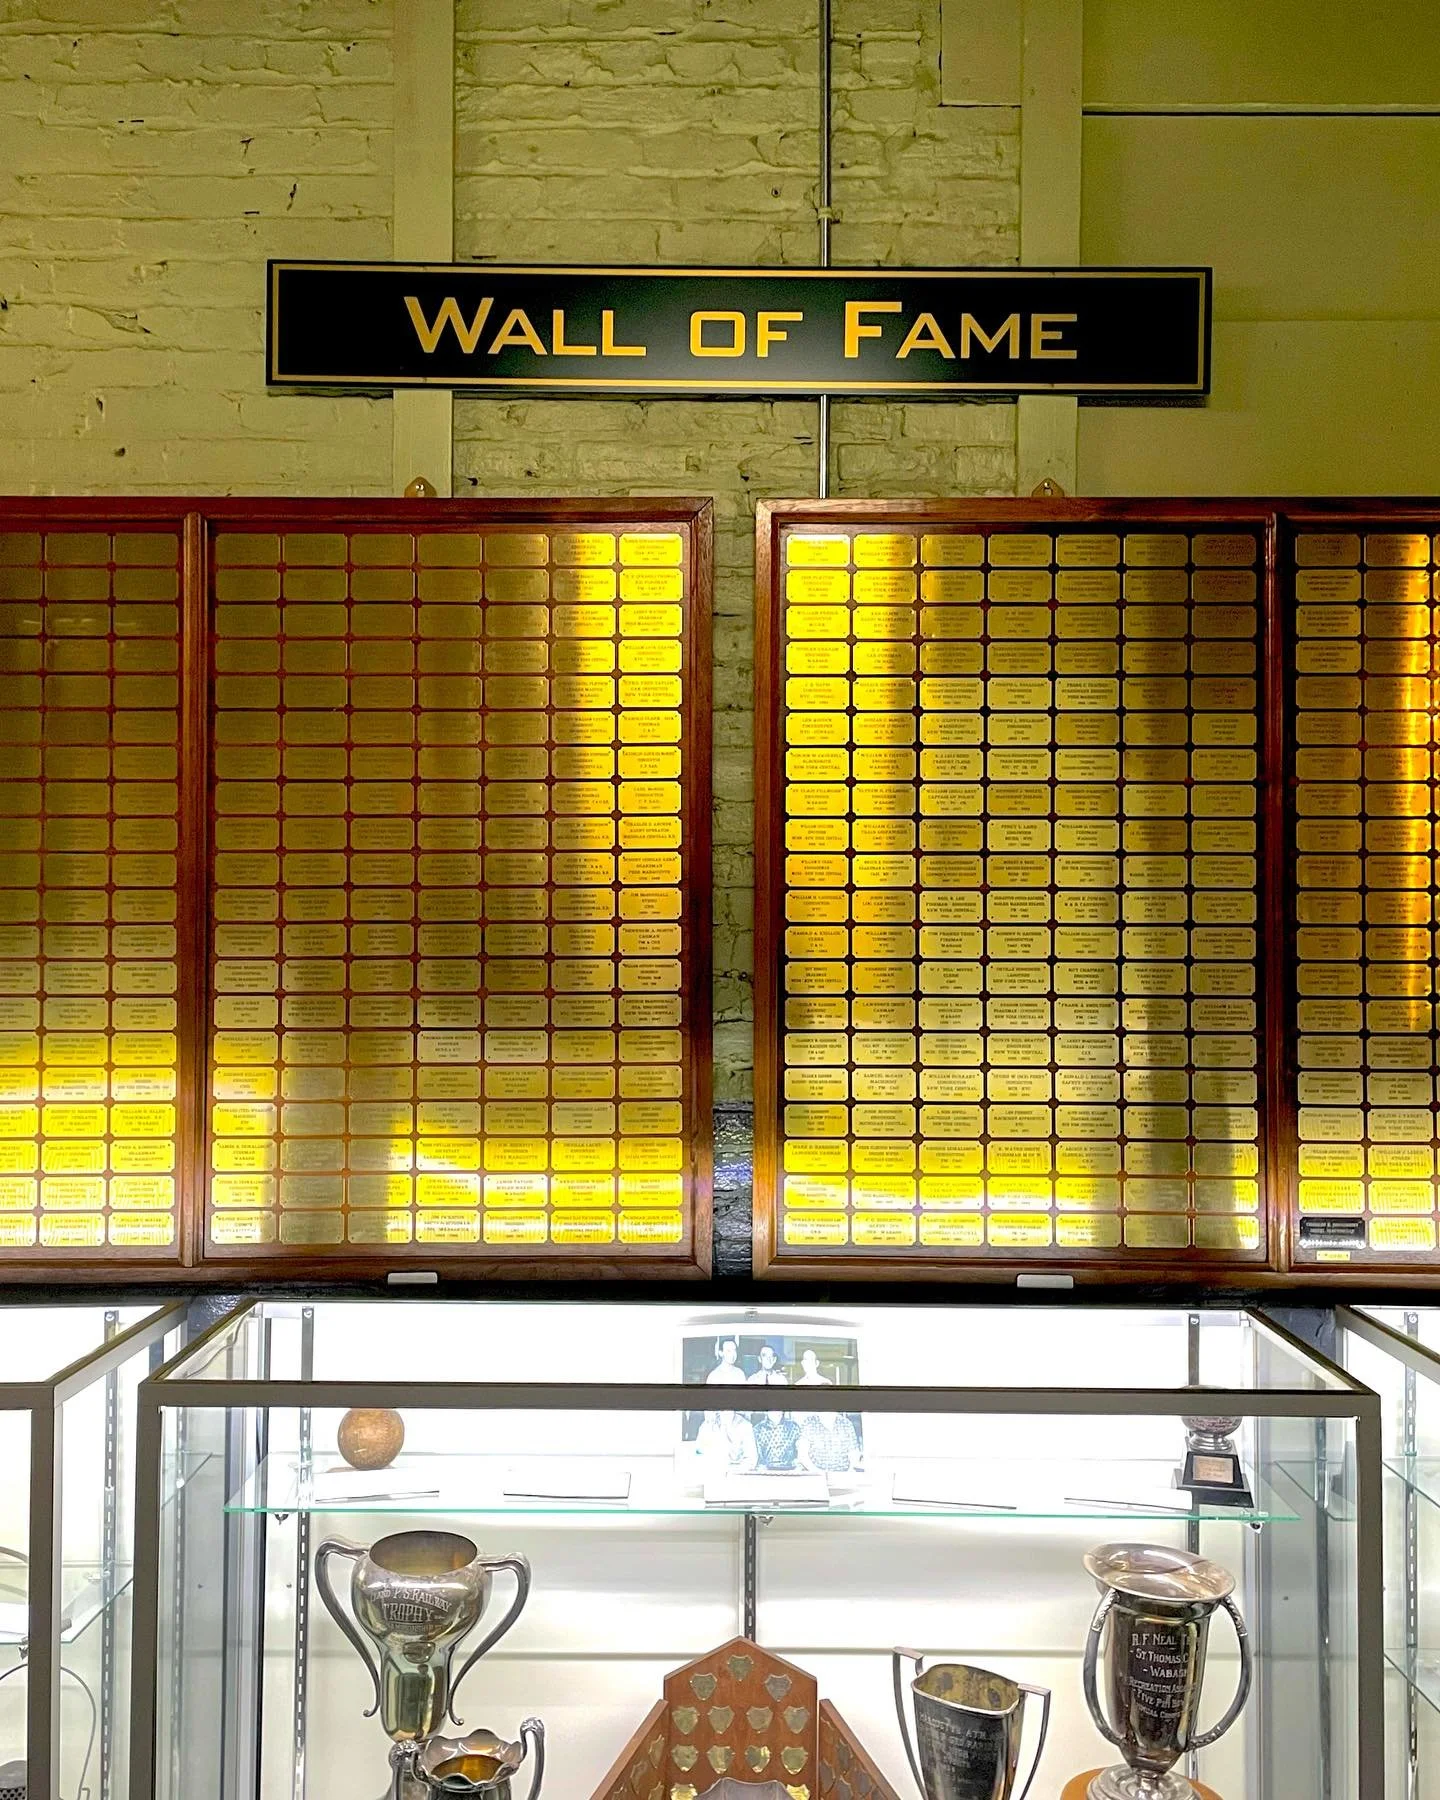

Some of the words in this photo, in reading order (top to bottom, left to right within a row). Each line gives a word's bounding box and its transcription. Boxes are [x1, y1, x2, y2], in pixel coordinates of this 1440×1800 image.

[404, 296, 647, 356] WALL
[690, 311, 803, 358] OF
[844, 301, 1078, 359] FAME
[383, 1602, 434, 1622] TROPHY
[1152, 1633, 1177, 1646] NEAL
